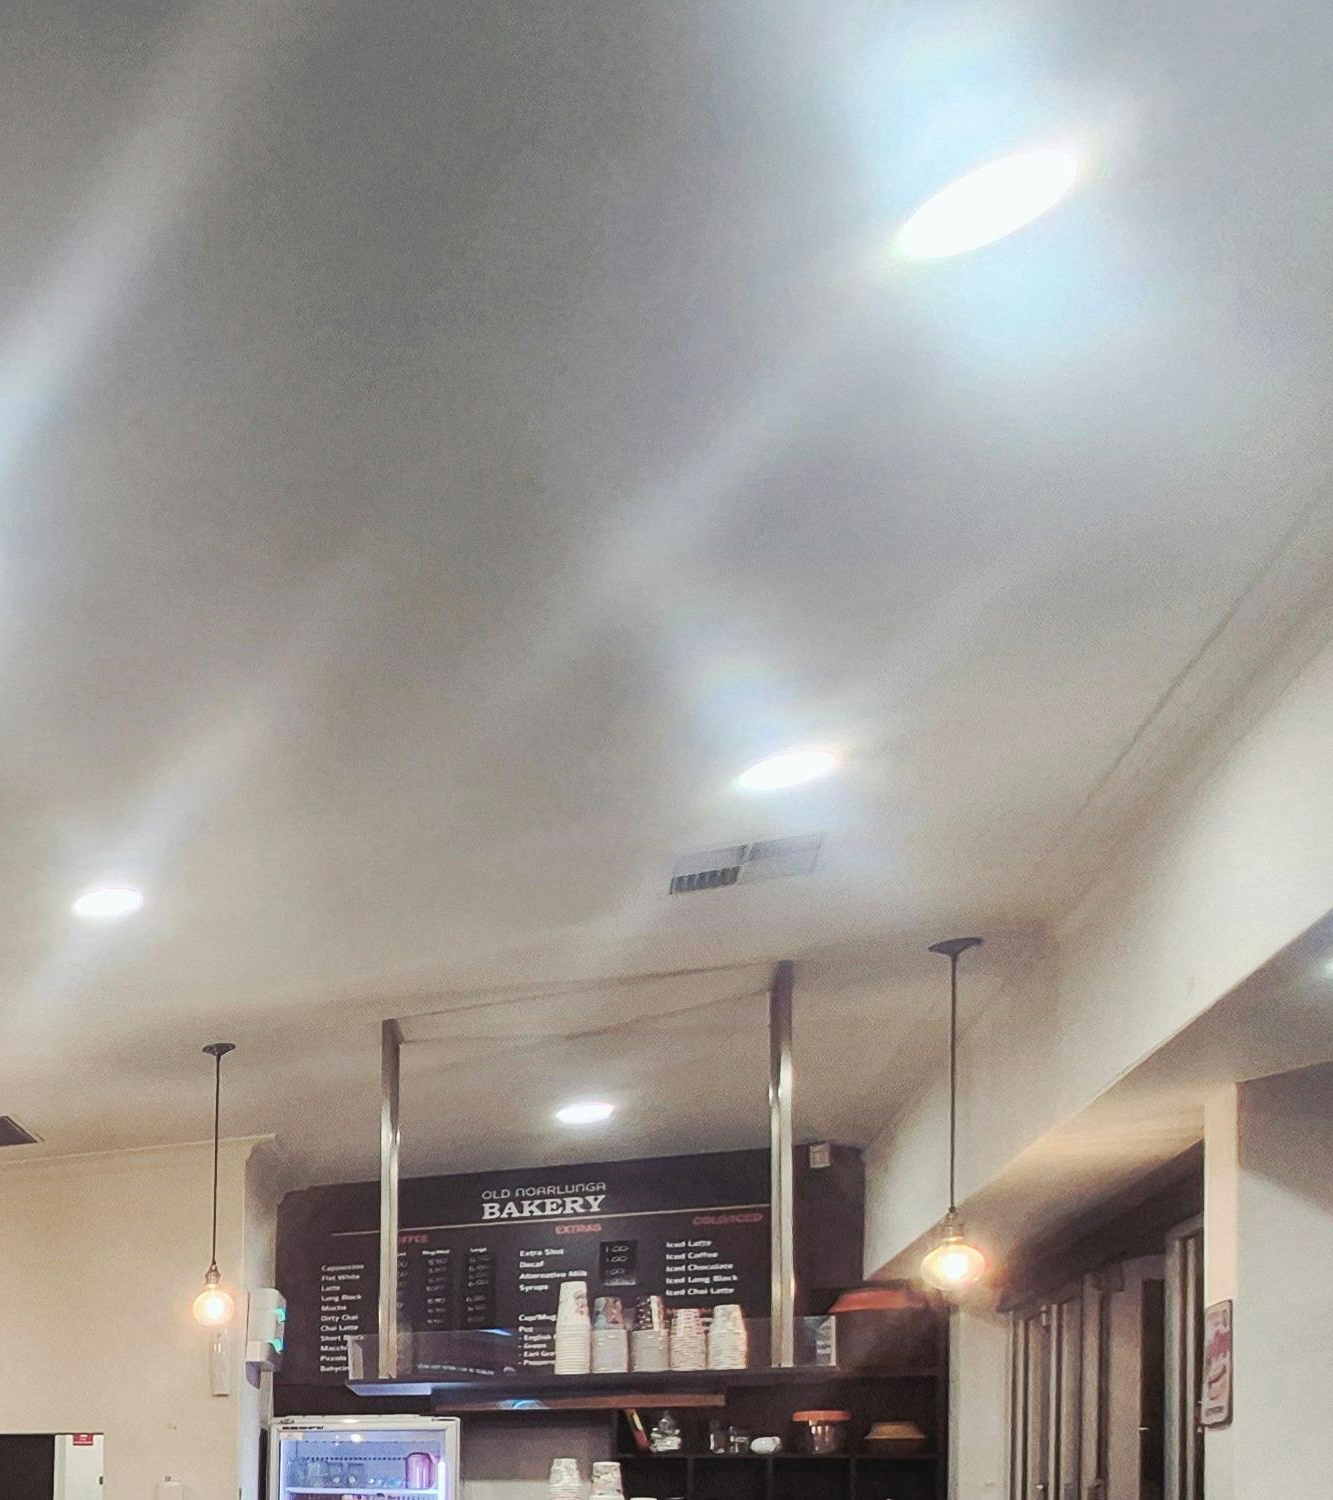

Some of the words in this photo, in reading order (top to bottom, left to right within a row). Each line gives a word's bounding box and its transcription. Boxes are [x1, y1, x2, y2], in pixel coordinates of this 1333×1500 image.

[481, 1190, 511, 1200] OLD
[515, 1181, 607, 1197] NOARLUNGA
[481, 1194, 606, 1220] BAKERY
[555, 1223, 603, 1235] EXTRAS
[519, 1249, 543, 1258] Extra
[544, 1248, 565, 1256] Shot
[665, 1277, 686, 1285] Iced
[320, 1314, 340, 1323] Dirty
